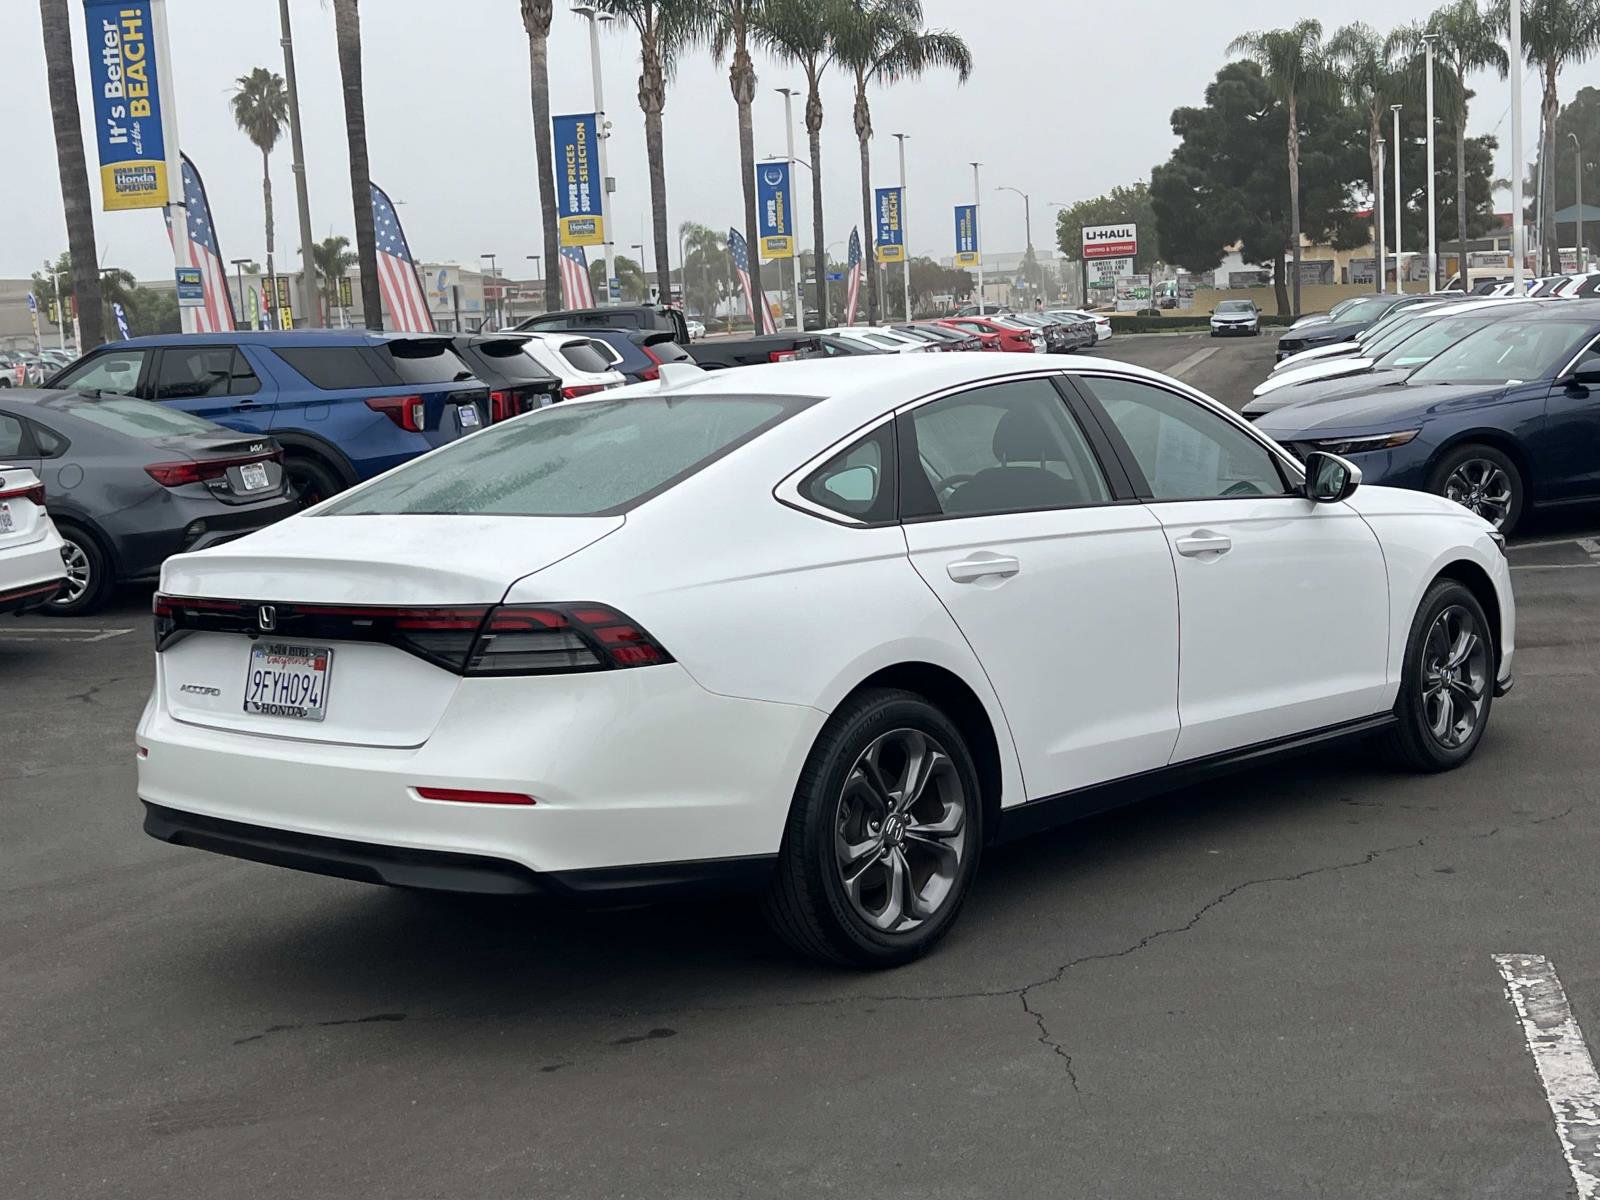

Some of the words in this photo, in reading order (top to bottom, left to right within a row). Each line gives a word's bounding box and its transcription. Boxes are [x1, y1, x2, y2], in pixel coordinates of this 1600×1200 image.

[102, 19, 123, 98] Better
[120, 9, 151, 117] BEACH!
[107, 105, 128, 144] It's
[566, 144, 577, 183] PRICES
[576, 122, 589, 181] SELECTION
[117, 173, 154, 184] Honda
[1086, 229, 1133, 240] U-HAUL
[179, 684, 221, 697] ACCORD
[250, 670, 318, 707] 9FYH094
[261, 702, 304, 717] HONDA
